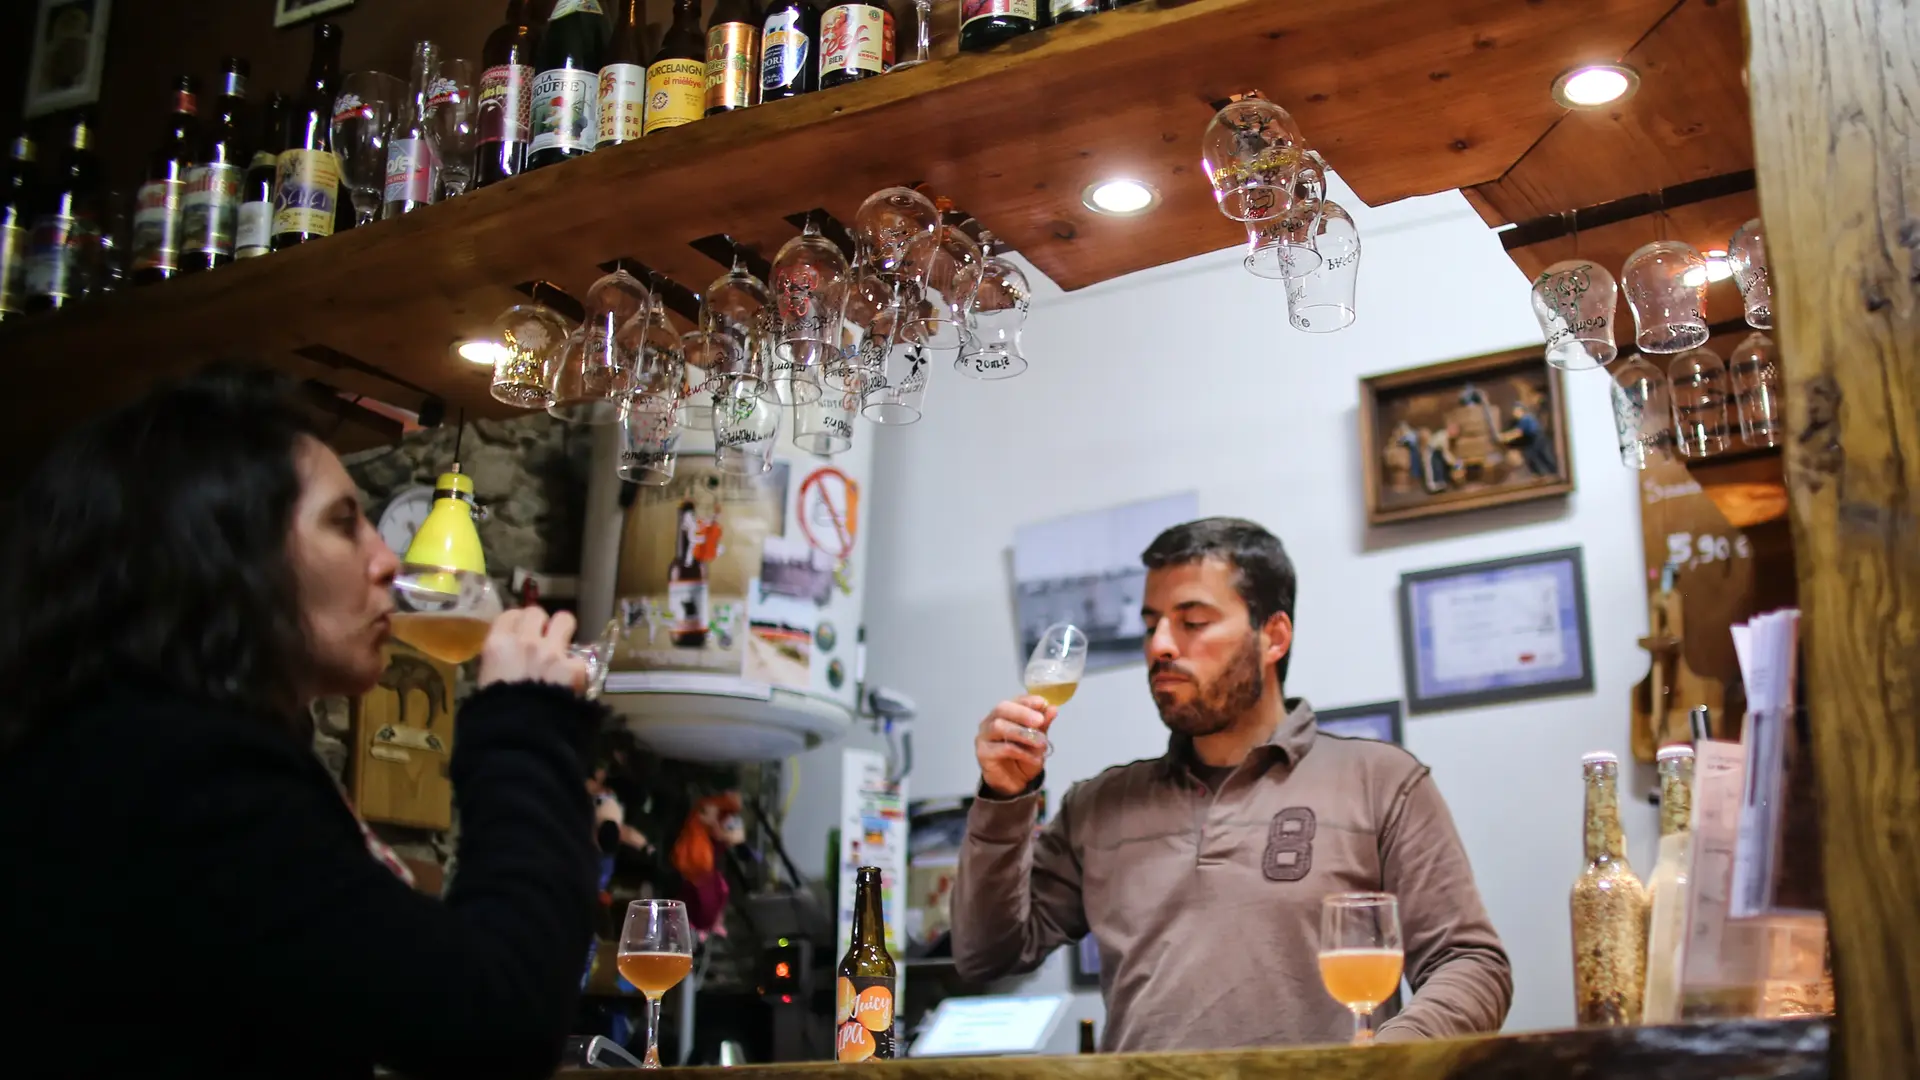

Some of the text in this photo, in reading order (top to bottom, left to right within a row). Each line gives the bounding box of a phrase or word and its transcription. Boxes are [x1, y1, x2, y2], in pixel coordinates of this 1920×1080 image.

[829, 54, 843, 64] BIER
[541, 74, 553, 83] LA
[1262, 806, 1317, 882] 8
[849, 993, 891, 1020] Juicy
